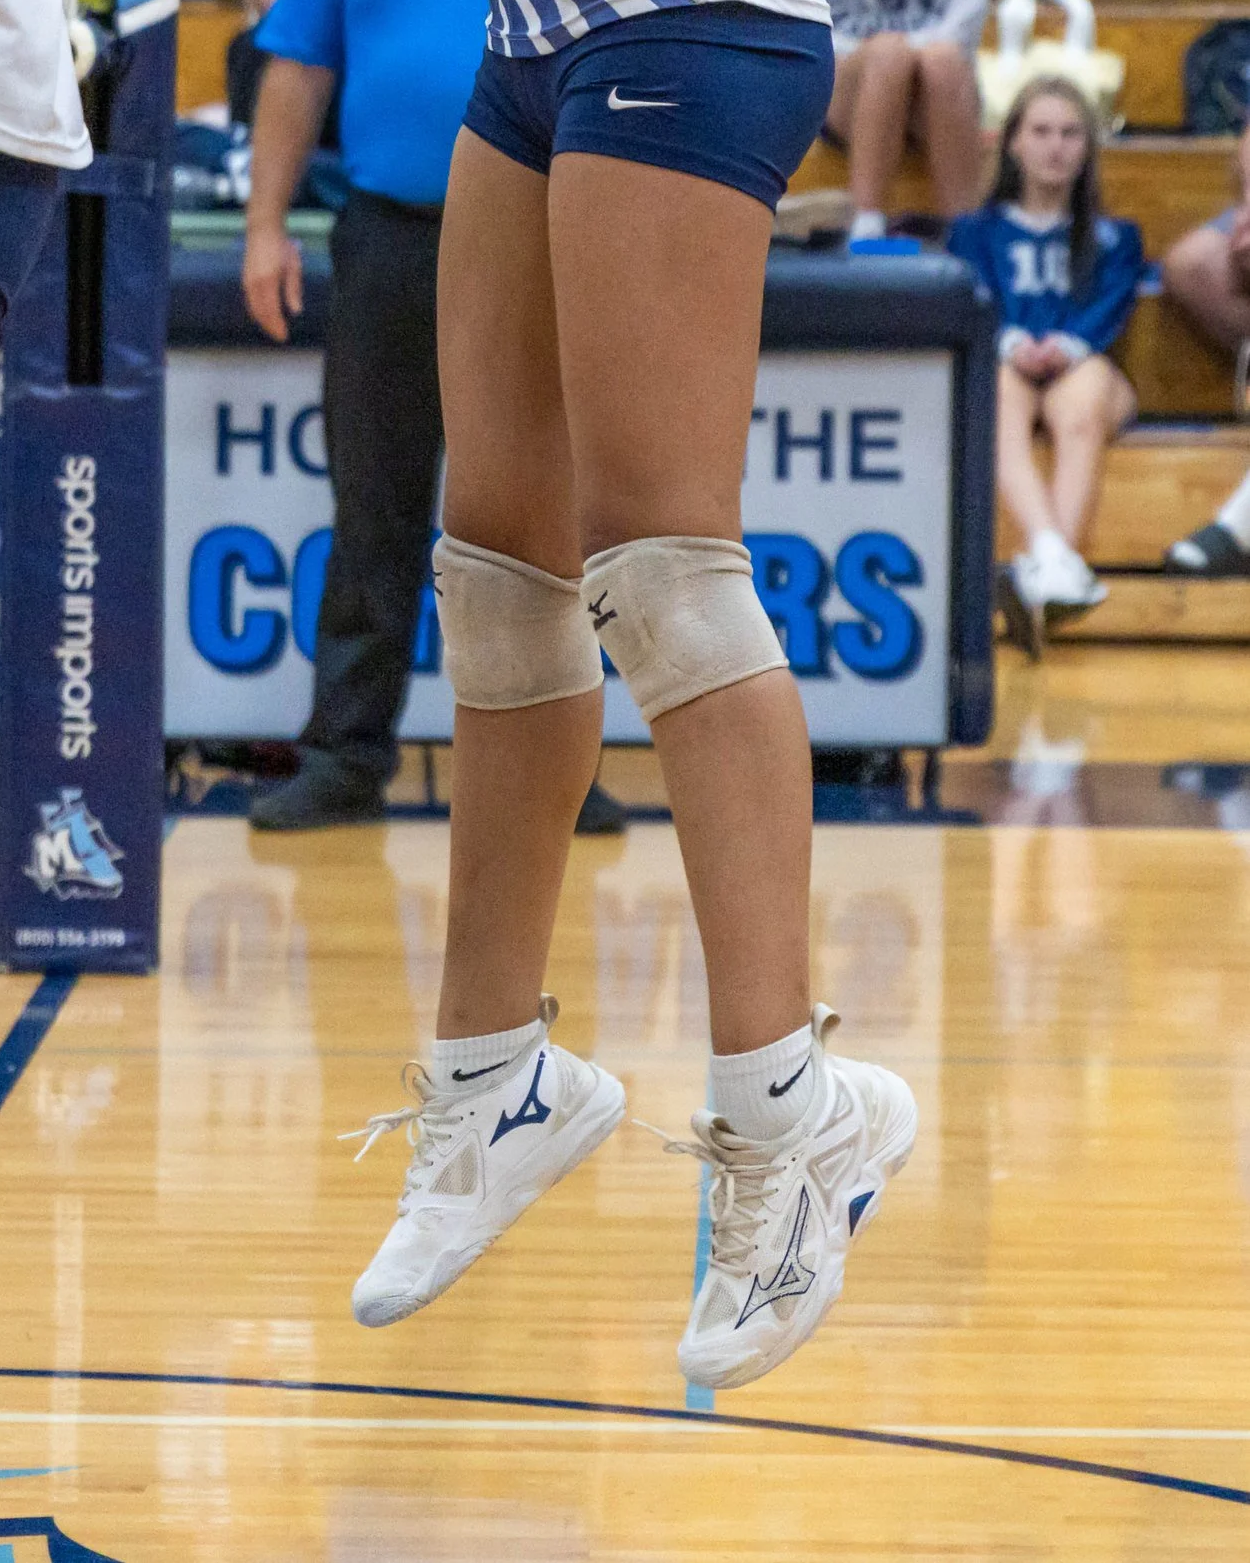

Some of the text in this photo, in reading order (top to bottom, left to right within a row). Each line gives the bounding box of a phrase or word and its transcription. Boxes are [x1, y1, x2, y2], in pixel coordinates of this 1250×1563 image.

[216, 402, 329, 480] HO
[54, 454, 99, 760] sports imports
